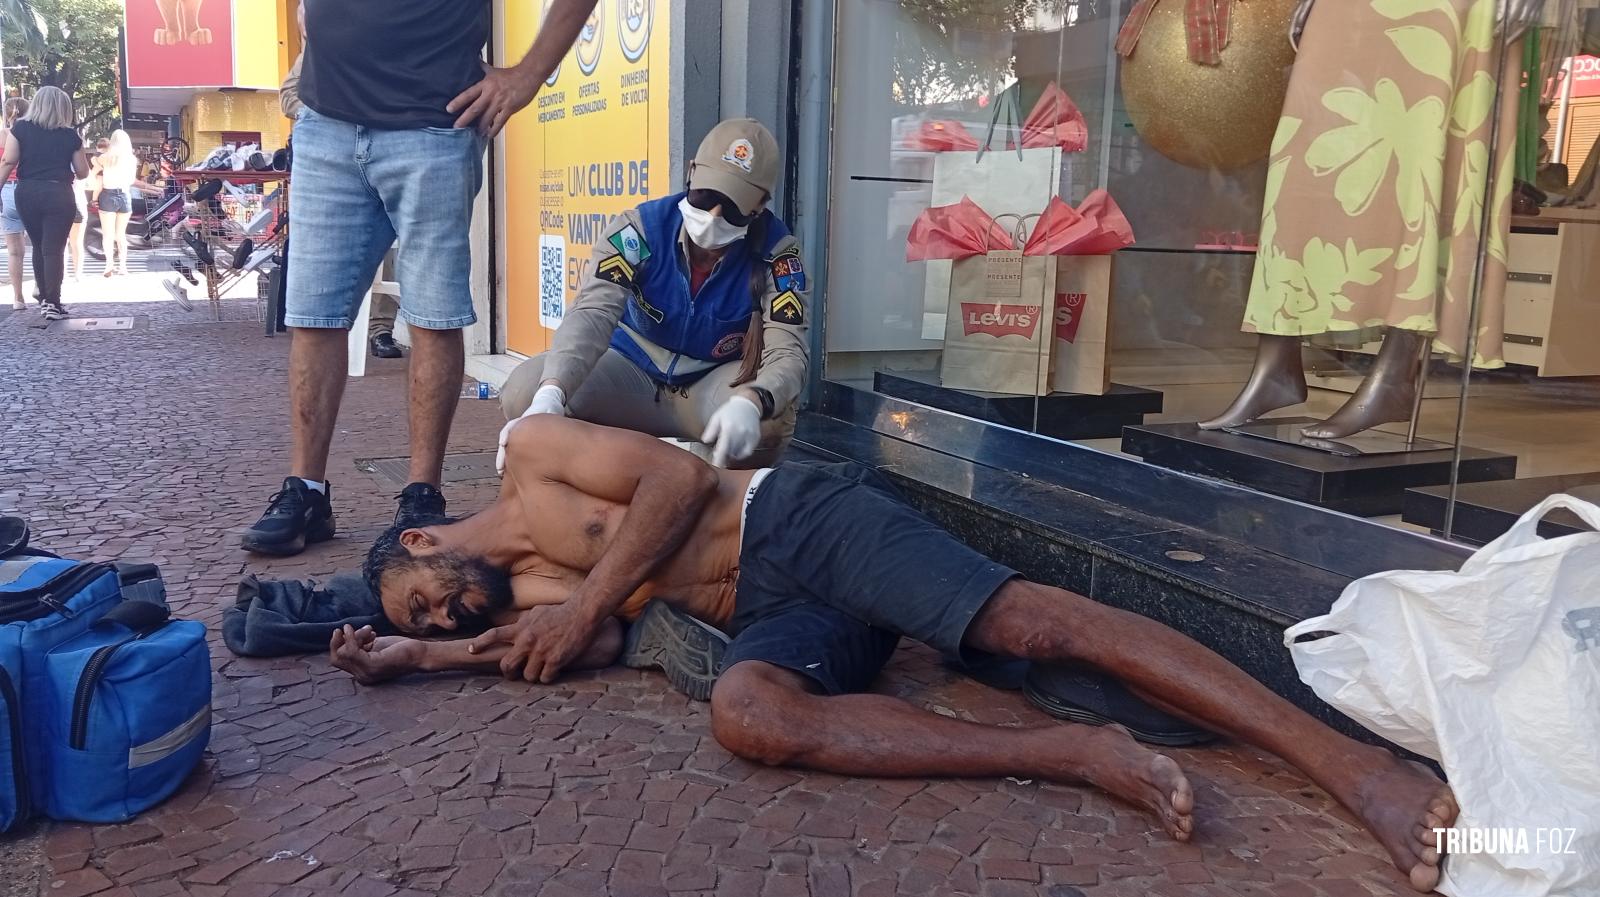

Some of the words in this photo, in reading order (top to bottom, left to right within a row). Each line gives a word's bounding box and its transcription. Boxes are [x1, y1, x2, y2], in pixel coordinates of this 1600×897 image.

[620, 69, 648, 89] DINHEIRO
[578, 81, 600, 98] OFERTAS
[621, 92, 629, 106] DE
[630, 88, 648, 105] VOLTA
[537, 93, 558, 108] DESCONTO
[572, 98, 607, 117] PERSONALIZADAS
[567, 165, 586, 197] UM
[588, 161, 624, 197] CLUB
[628, 159, 648, 196] DE
